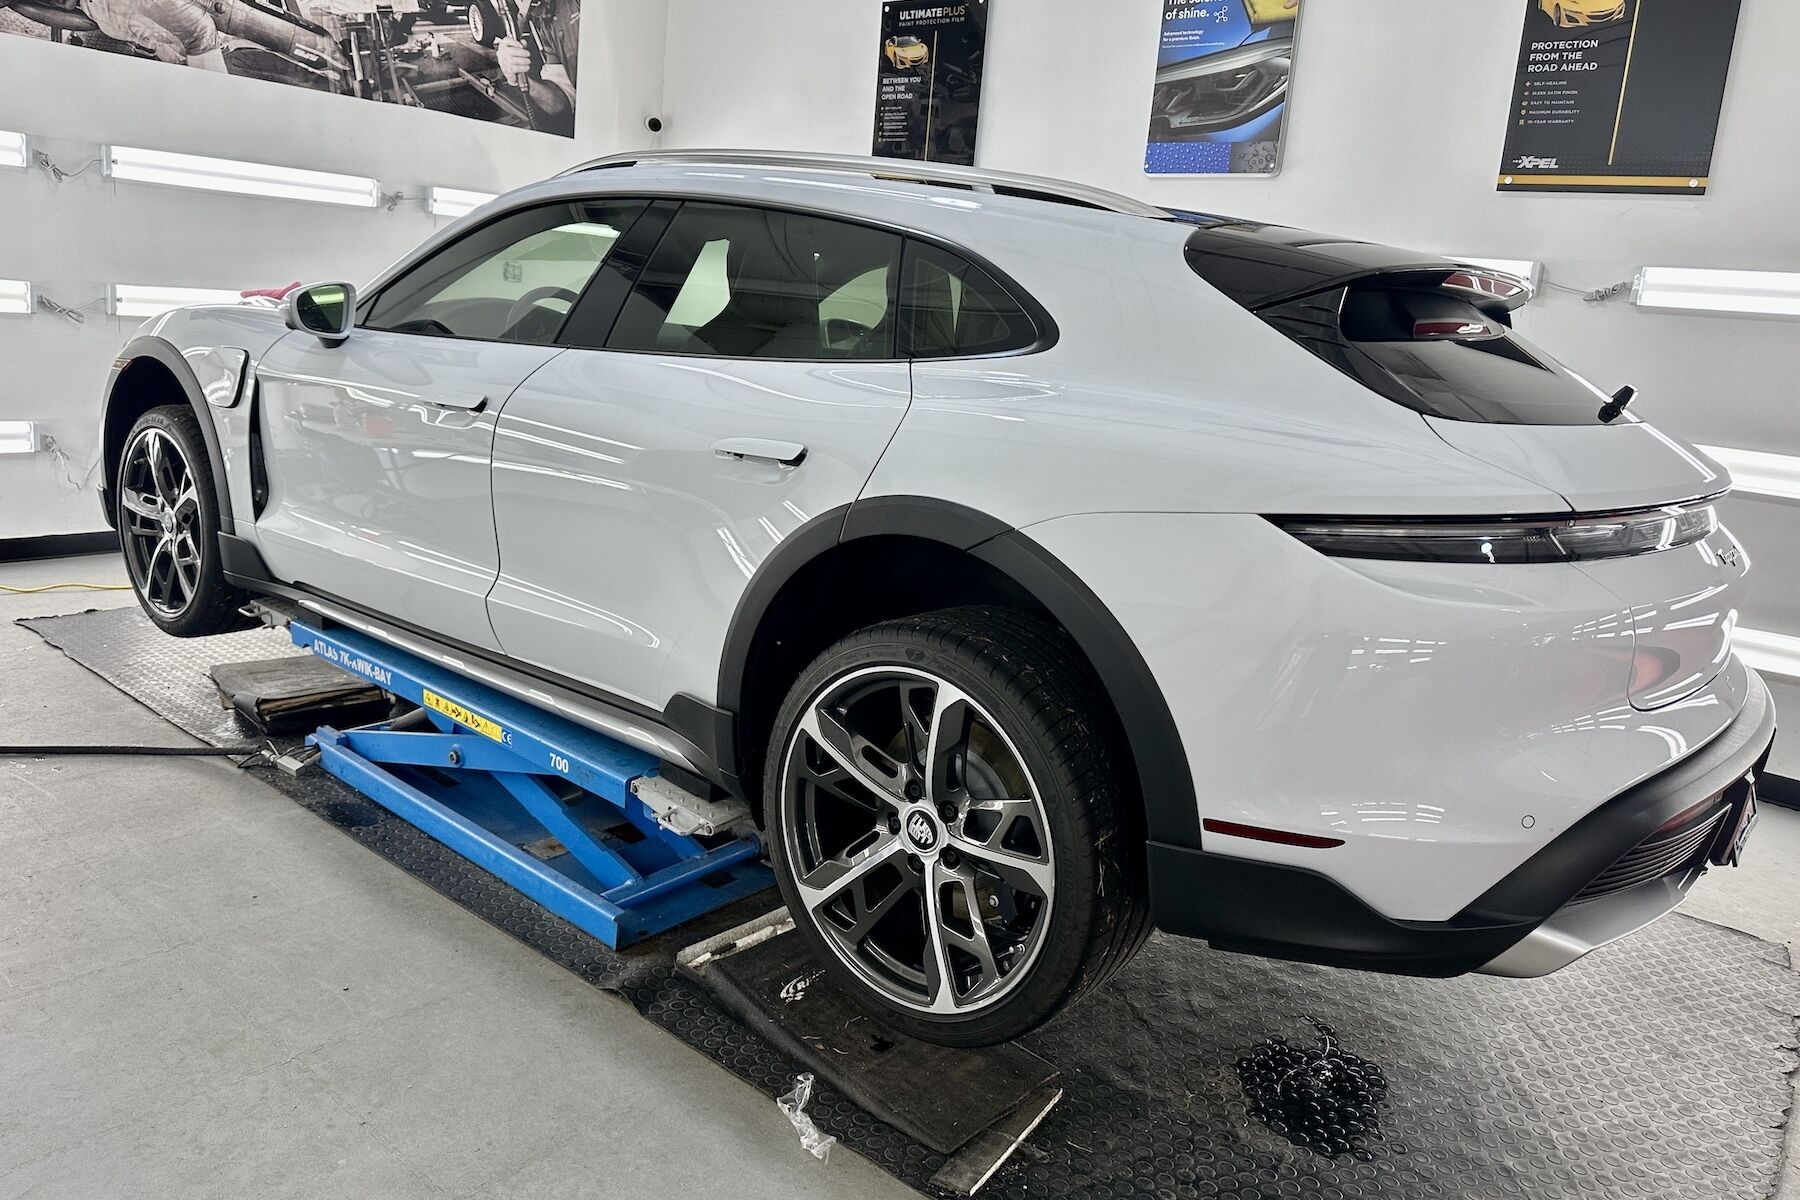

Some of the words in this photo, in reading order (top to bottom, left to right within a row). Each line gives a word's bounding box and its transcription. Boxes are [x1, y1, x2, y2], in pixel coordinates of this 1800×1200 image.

[1165, 8, 1177, 20] of
[1178, 7, 1209, 19] shine.
[916, 18, 950, 26] PROTECTION
[1531, 39, 1599, 51] PROTECTION
[1529, 52, 1559, 61] FROM
[1562, 51, 1582, 60] THE
[1527, 63, 1558, 72] ROAD
[1560, 62, 1598, 71] AHEAD
[1517, 155, 1559, 169] XPEL
[313, 639, 338, 661] ATLAS
[550, 753, 569, 773] 700
